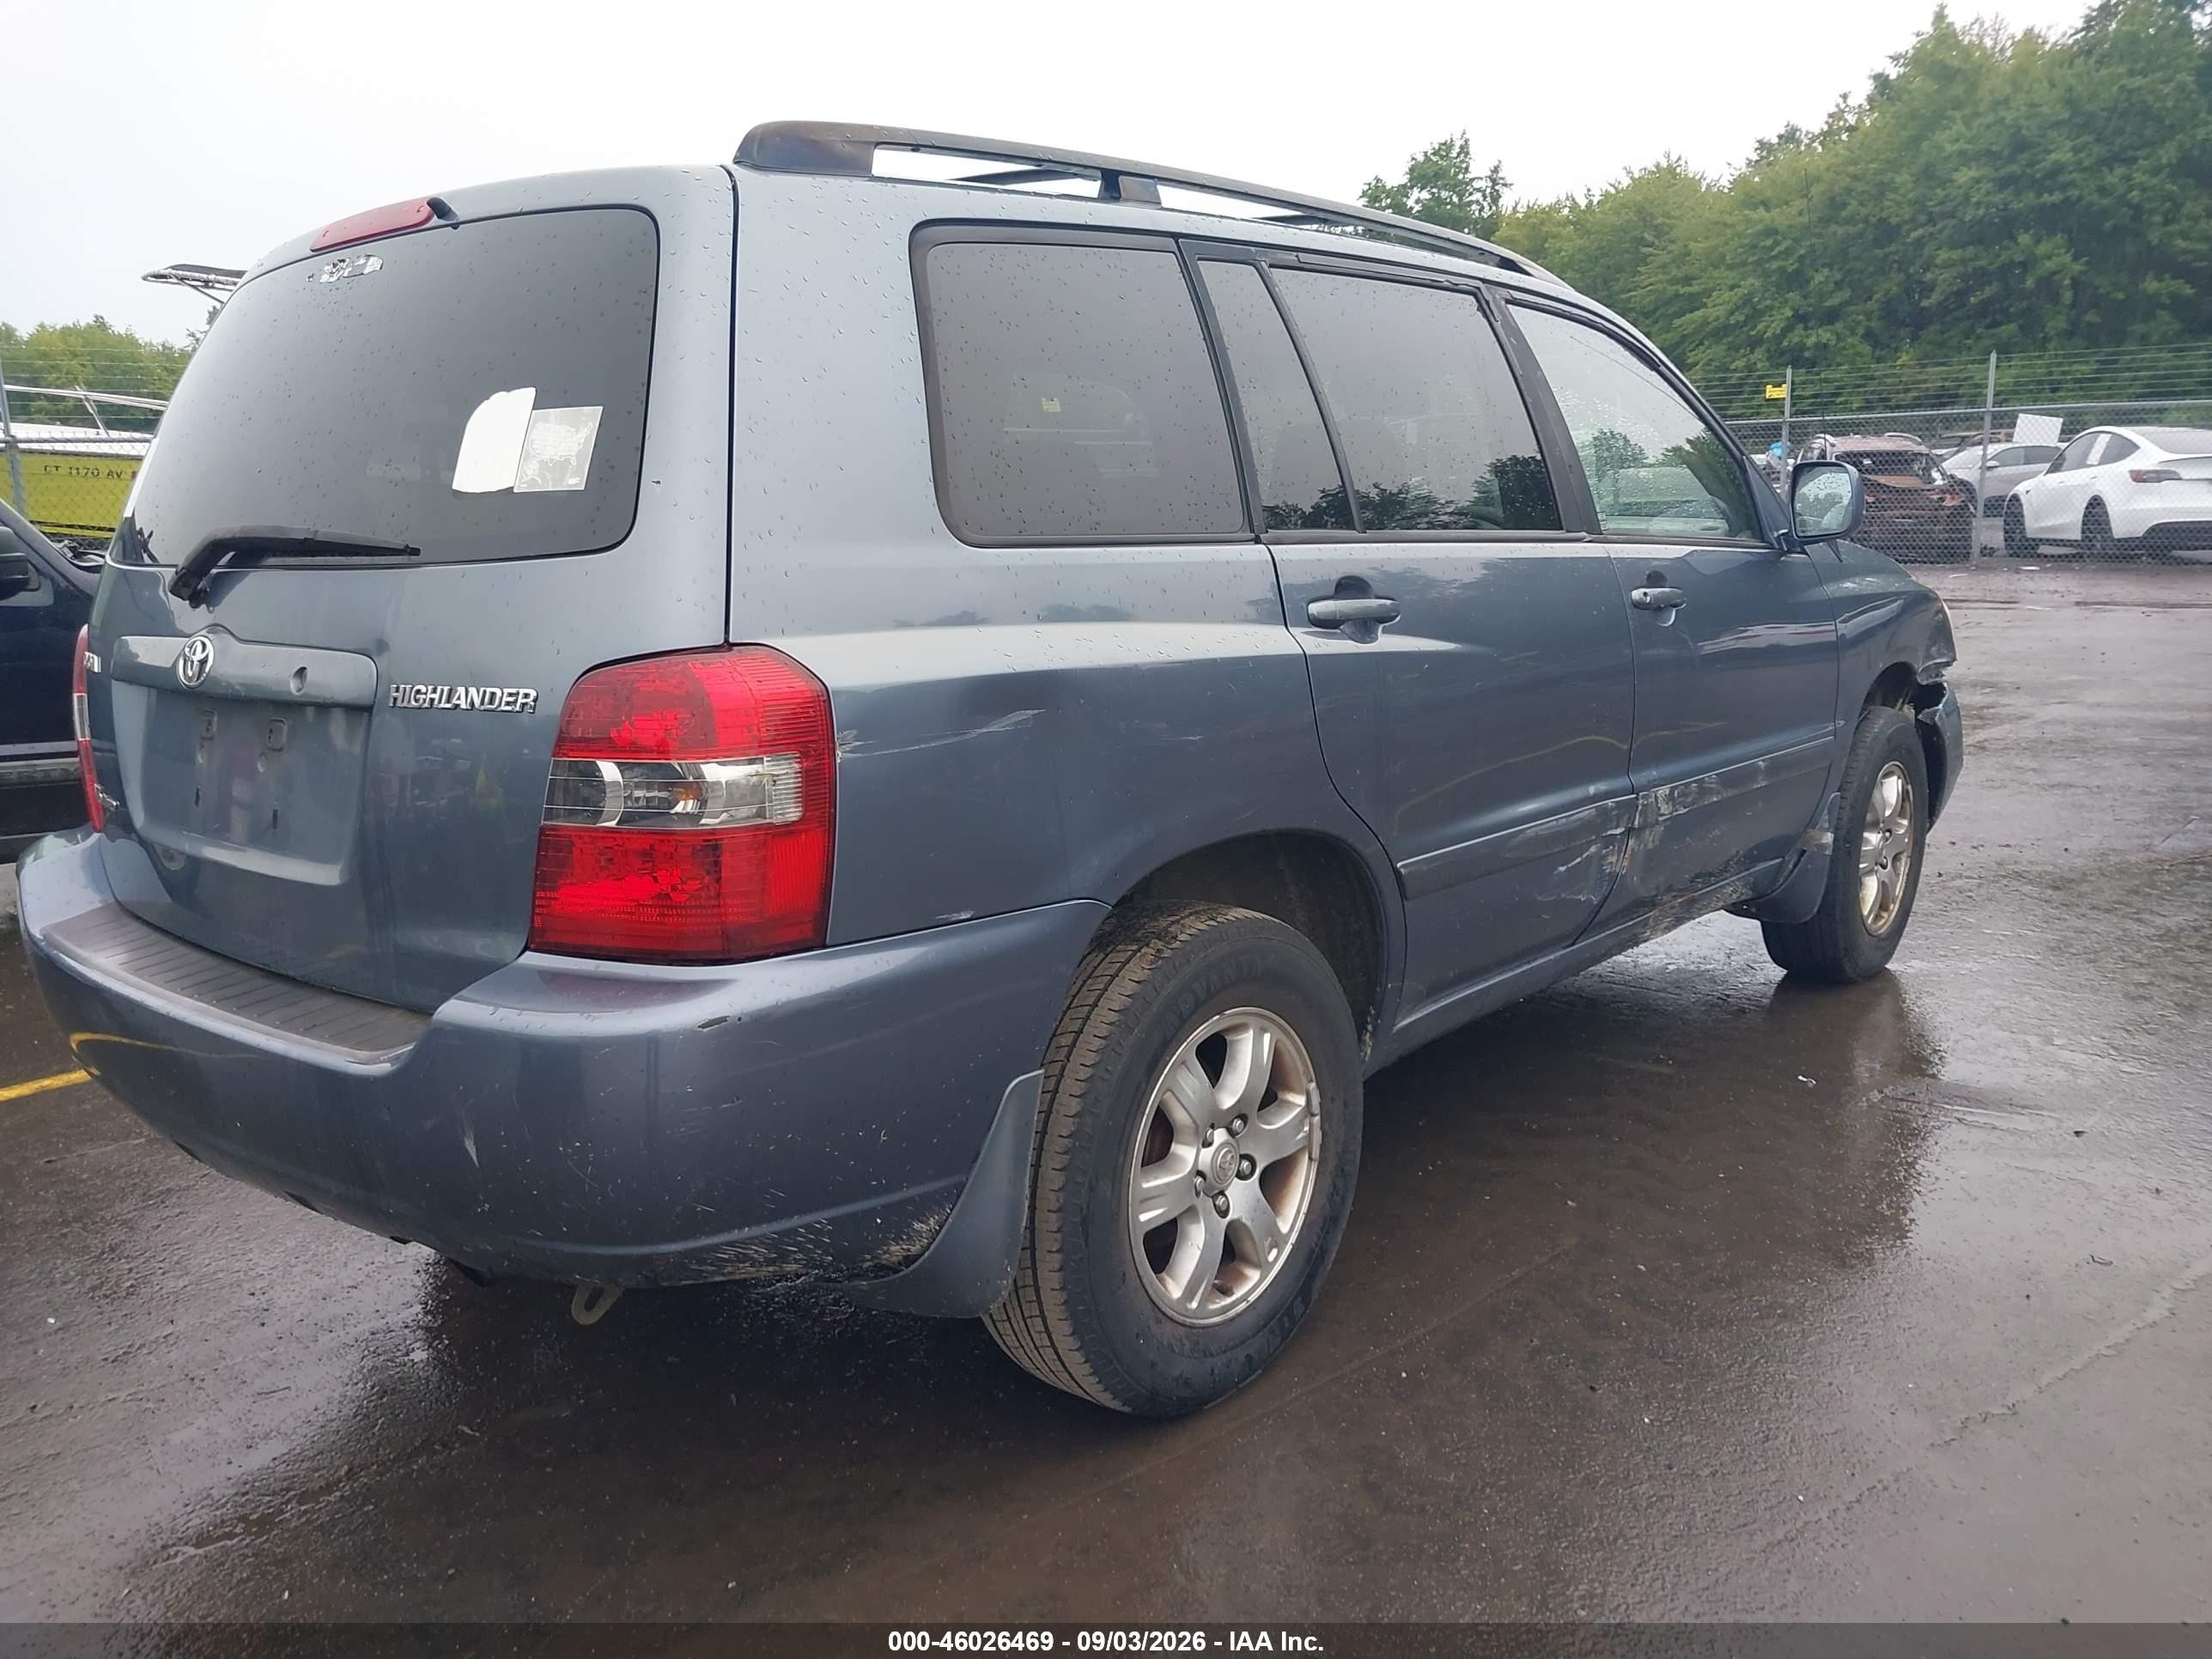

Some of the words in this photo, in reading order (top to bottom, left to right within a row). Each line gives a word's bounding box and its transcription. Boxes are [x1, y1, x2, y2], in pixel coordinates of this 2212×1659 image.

[68, 466, 99, 477] 1170
[106, 470, 124, 479] AV
[388, 684, 538, 713] HIGHLANDER
